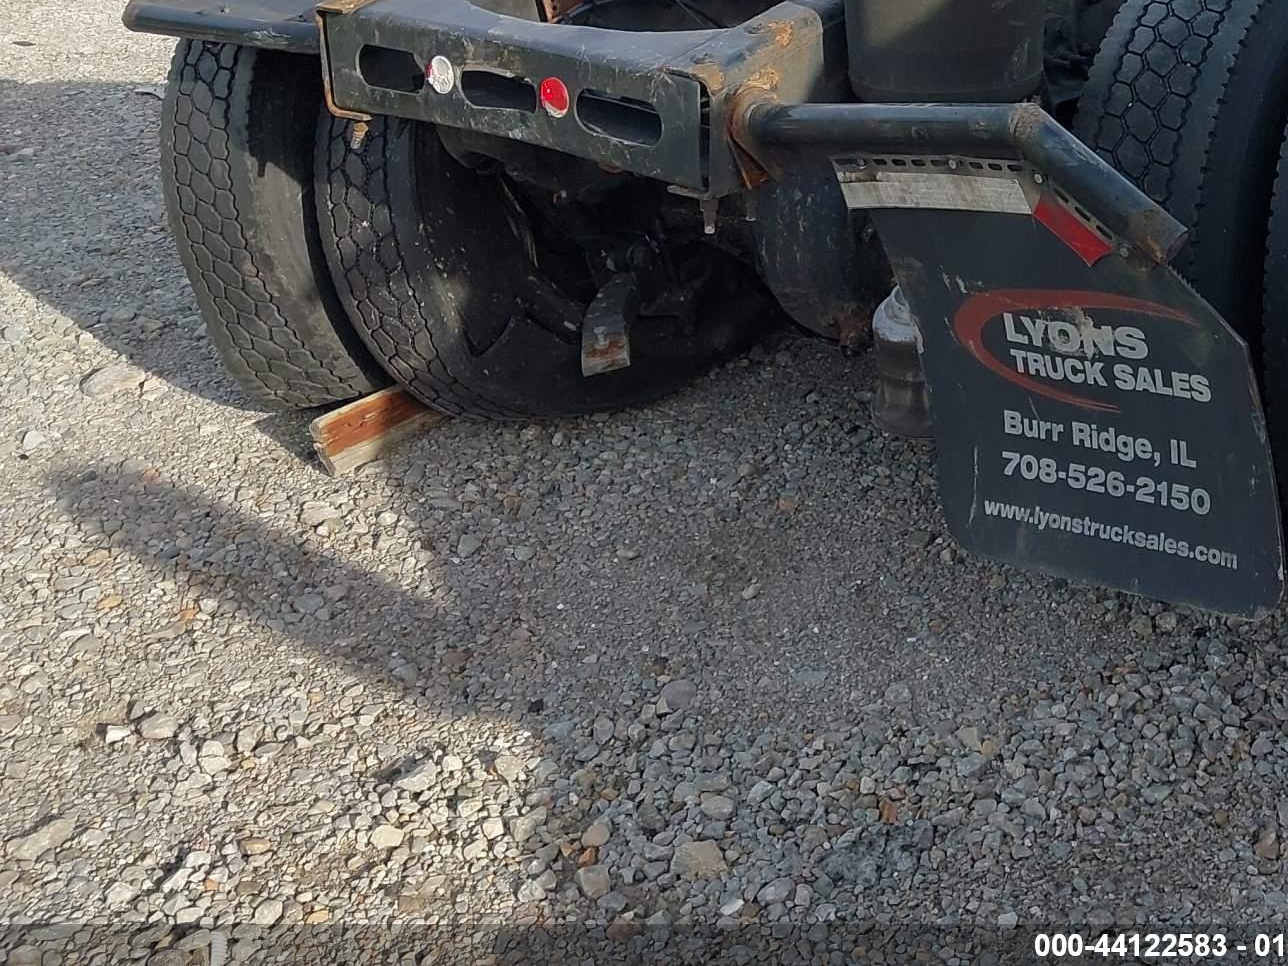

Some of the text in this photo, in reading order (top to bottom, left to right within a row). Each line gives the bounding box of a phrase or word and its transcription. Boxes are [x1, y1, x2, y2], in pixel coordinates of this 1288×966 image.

[1003, 312, 1148, 359] LYONS
[1010, 348, 1212, 403] TRUCK SALES
[1003, 409, 1197, 469] Burr Ridge, IL
[1001, 450, 1211, 515] 708-526-2150
[984, 499, 1239, 571] www.lyonstrucksales.com
